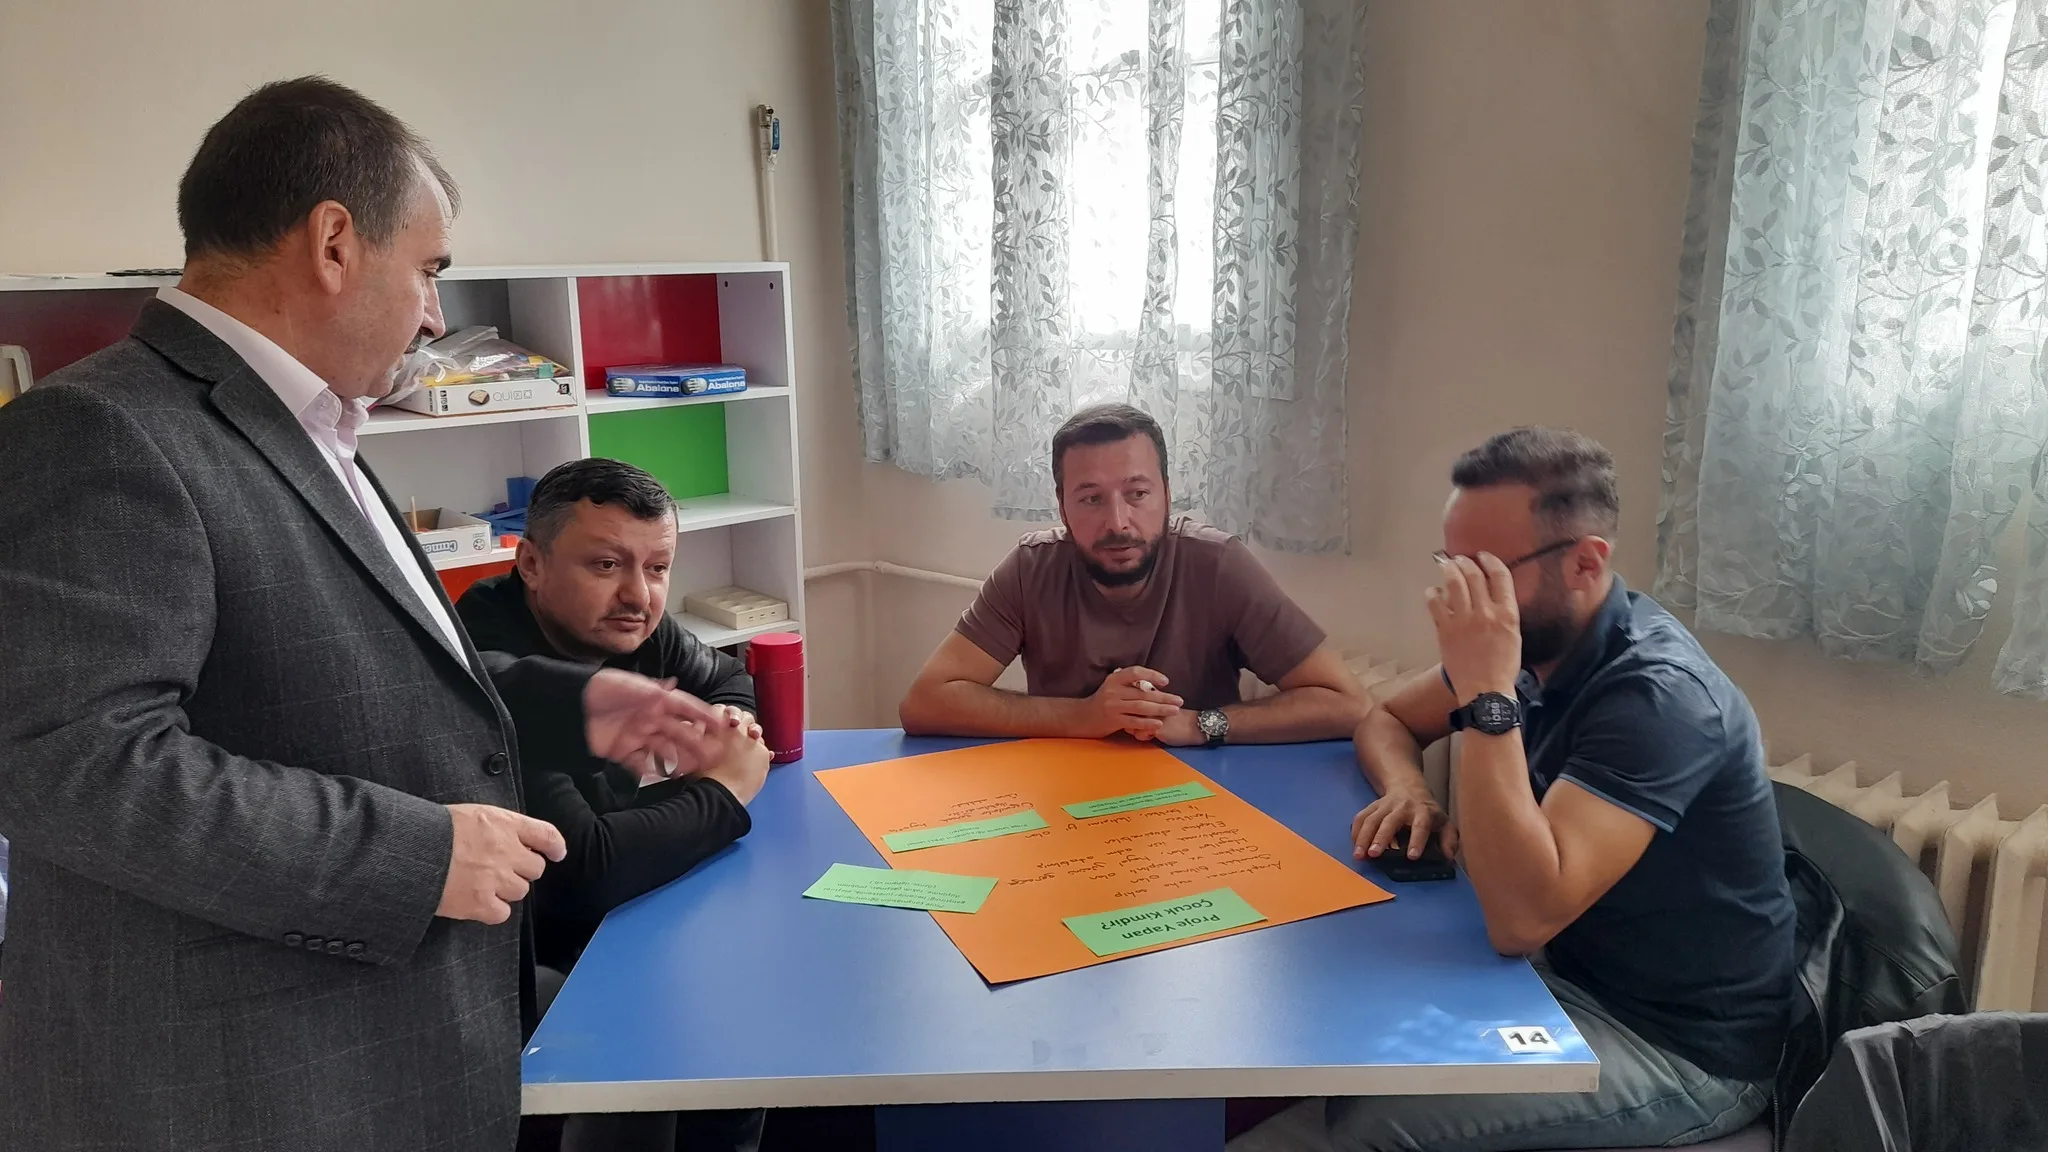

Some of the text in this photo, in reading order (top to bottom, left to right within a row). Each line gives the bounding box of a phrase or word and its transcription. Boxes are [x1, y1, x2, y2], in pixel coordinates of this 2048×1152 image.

[636, 384, 680, 393] Abalone
[707, 381, 746, 390] Abalone
[1101, 899, 1213, 930] Çocuk Kimdir?
[1122, 913, 1220, 940] Proje Yapan
[1508, 1031, 1549, 1045] 14
